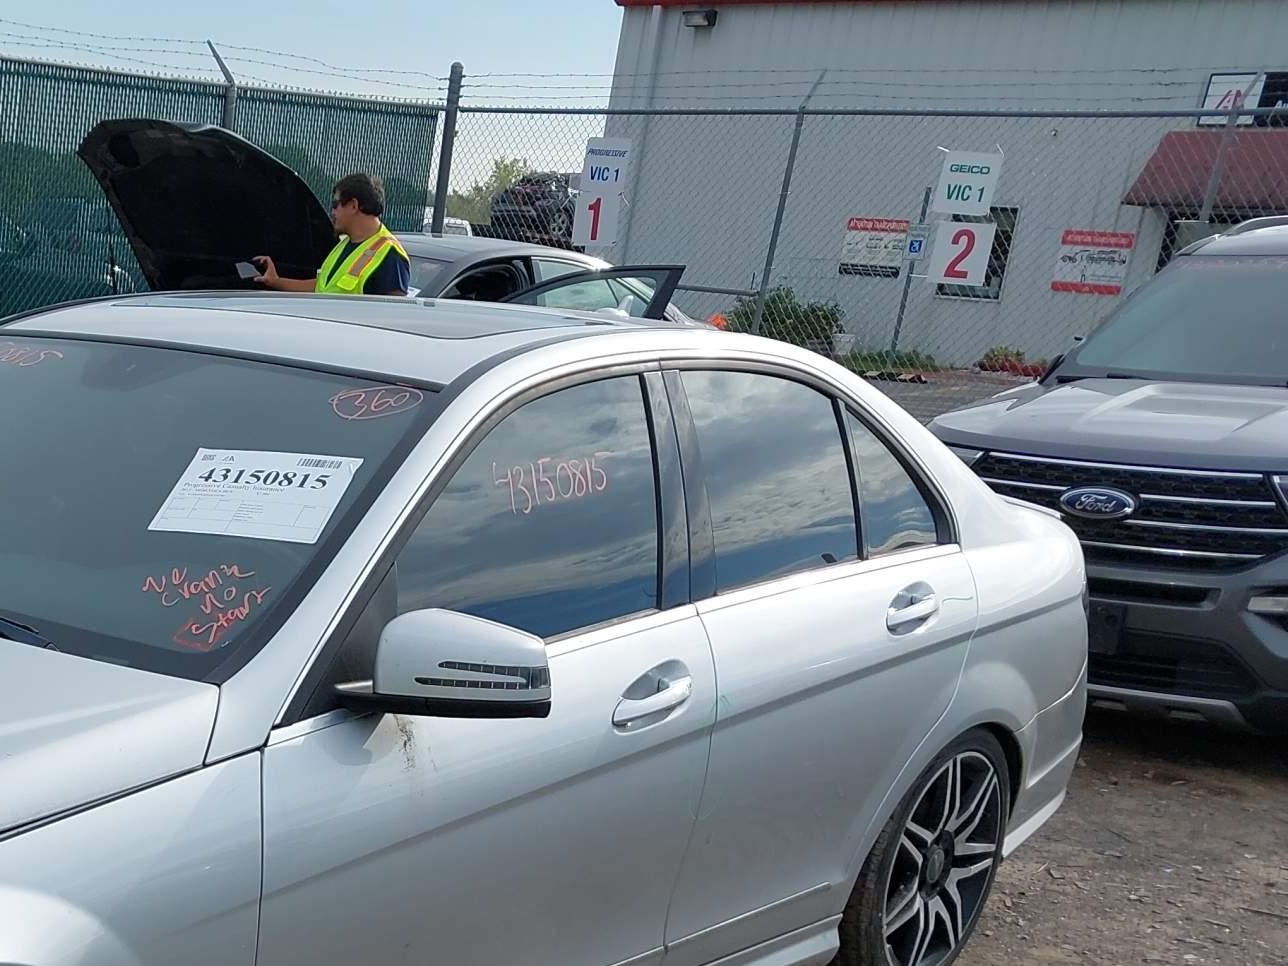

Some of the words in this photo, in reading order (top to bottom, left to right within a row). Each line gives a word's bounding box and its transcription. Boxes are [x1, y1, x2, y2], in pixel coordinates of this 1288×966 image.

[590, 165, 610, 182] VIC
[613, 167, 620, 182] 1
[950, 163, 991, 175] GEICO
[946, 183, 972, 202] VIC
[977, 186, 985, 203] 1
[588, 197, 602, 241] 1
[943, 228, 977, 280] 2
[338, 389, 411, 421] 360
[198, 467, 331, 490] 43150815
[492, 450, 612, 514] 43150815
[1075, 493, 1117, 512] Ford
